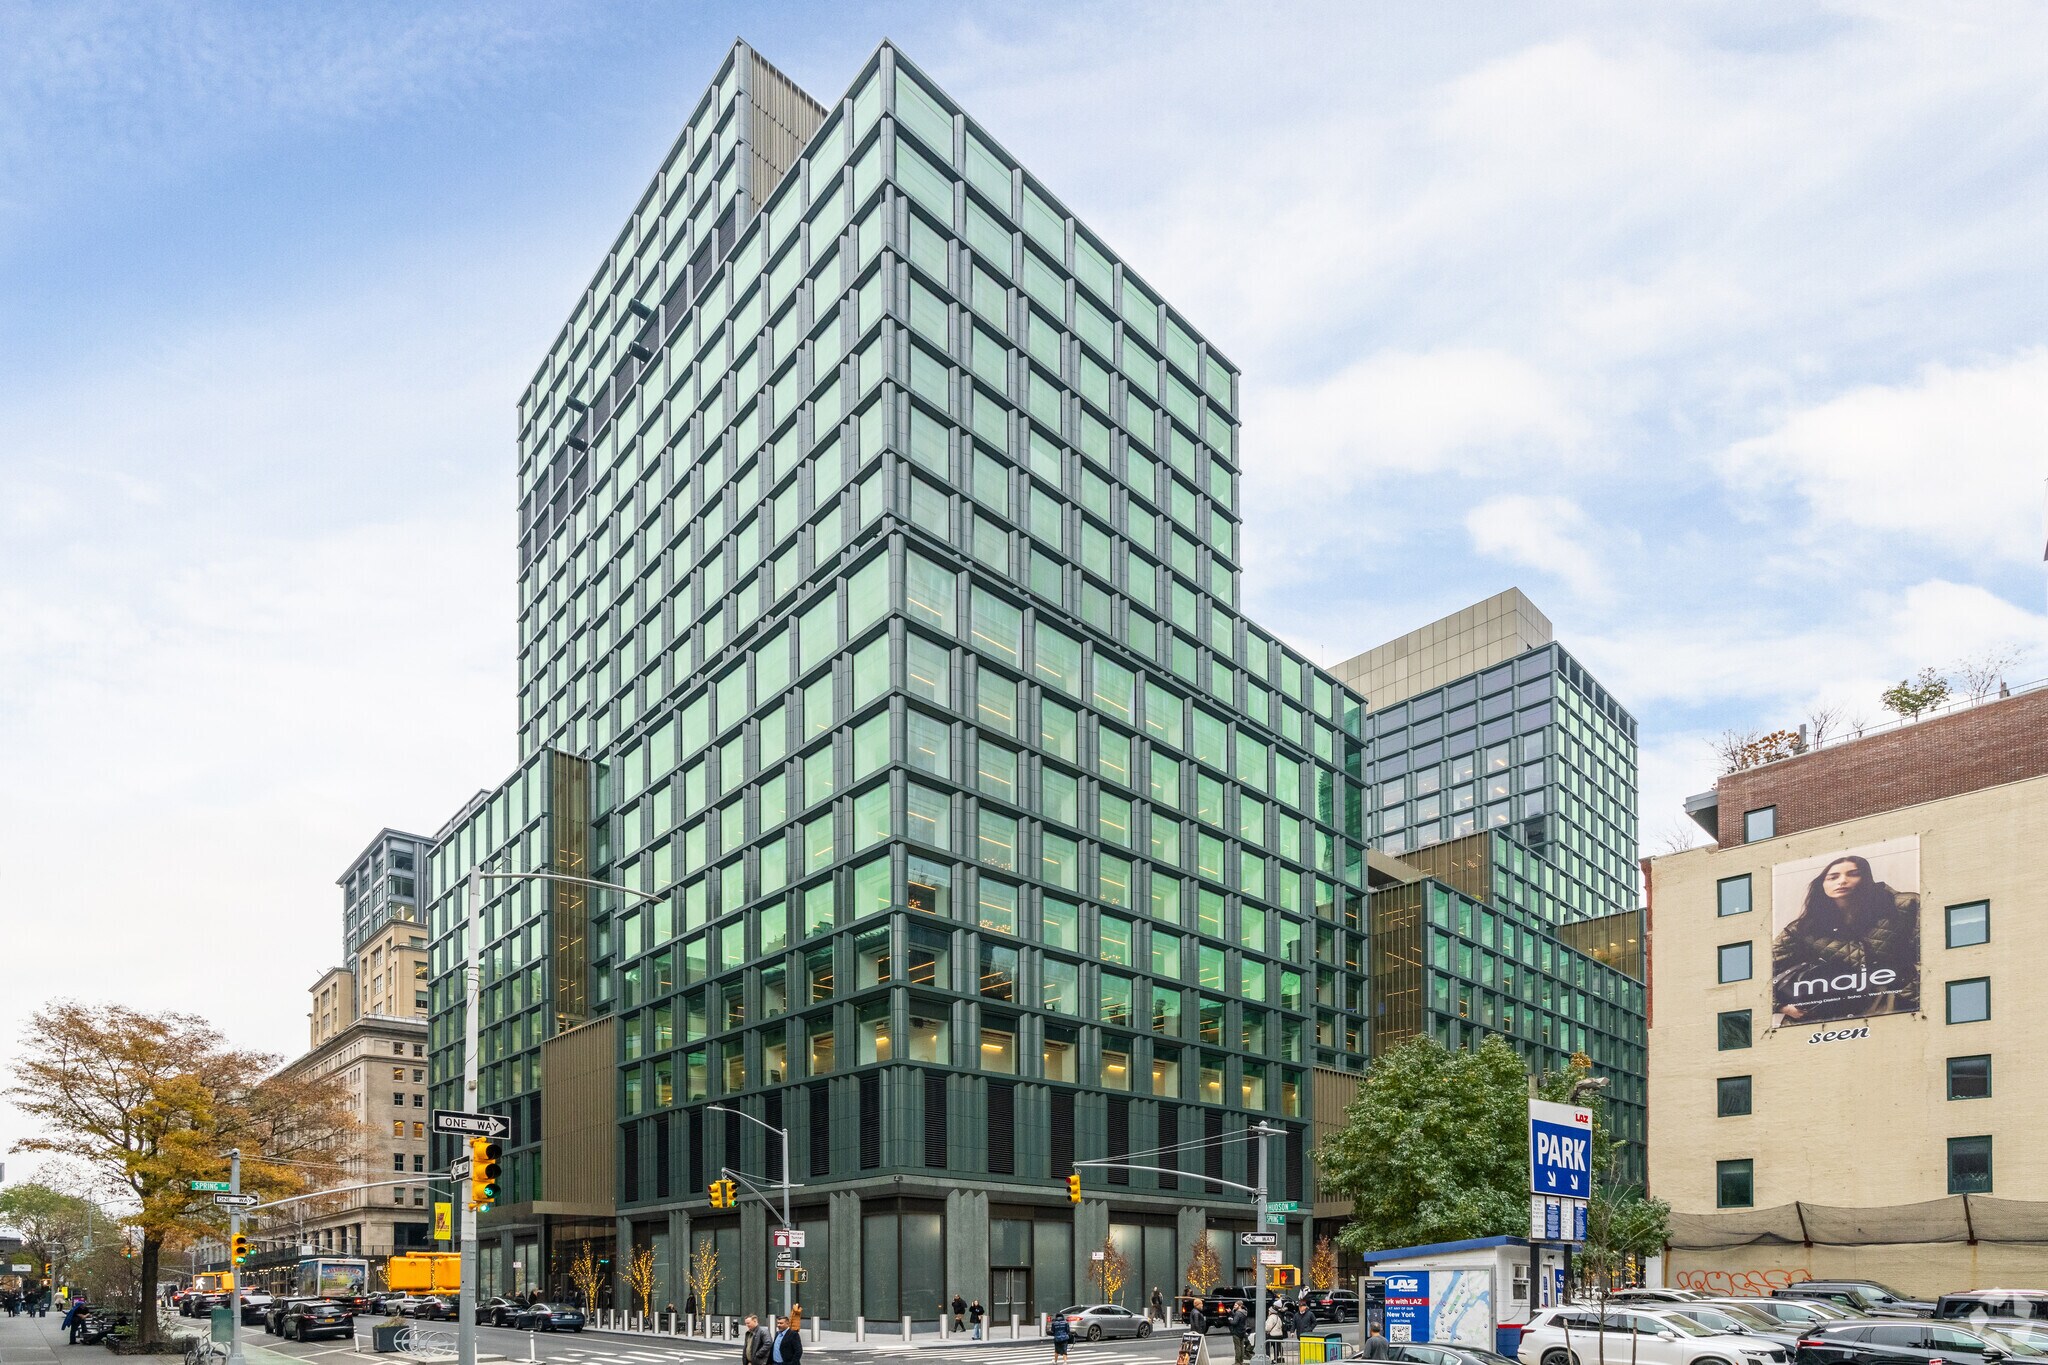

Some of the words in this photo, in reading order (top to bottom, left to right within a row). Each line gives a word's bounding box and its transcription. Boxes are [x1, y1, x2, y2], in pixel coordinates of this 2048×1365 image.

[1793, 967, 1897, 997] maje
[1809, 1027, 1869, 1044] seen
[445, 1117, 467, 1128] ONE
[477, 1121, 499, 1131] WAY
[1575, 1113, 1589, 1124] LAZ
[1537, 1131, 1587, 1172] PARK
[195, 1181, 219, 1190] SPRING
[1268, 1203, 1288, 1211] HUDSON
[1388, 1279, 1418, 1289] LAZ
